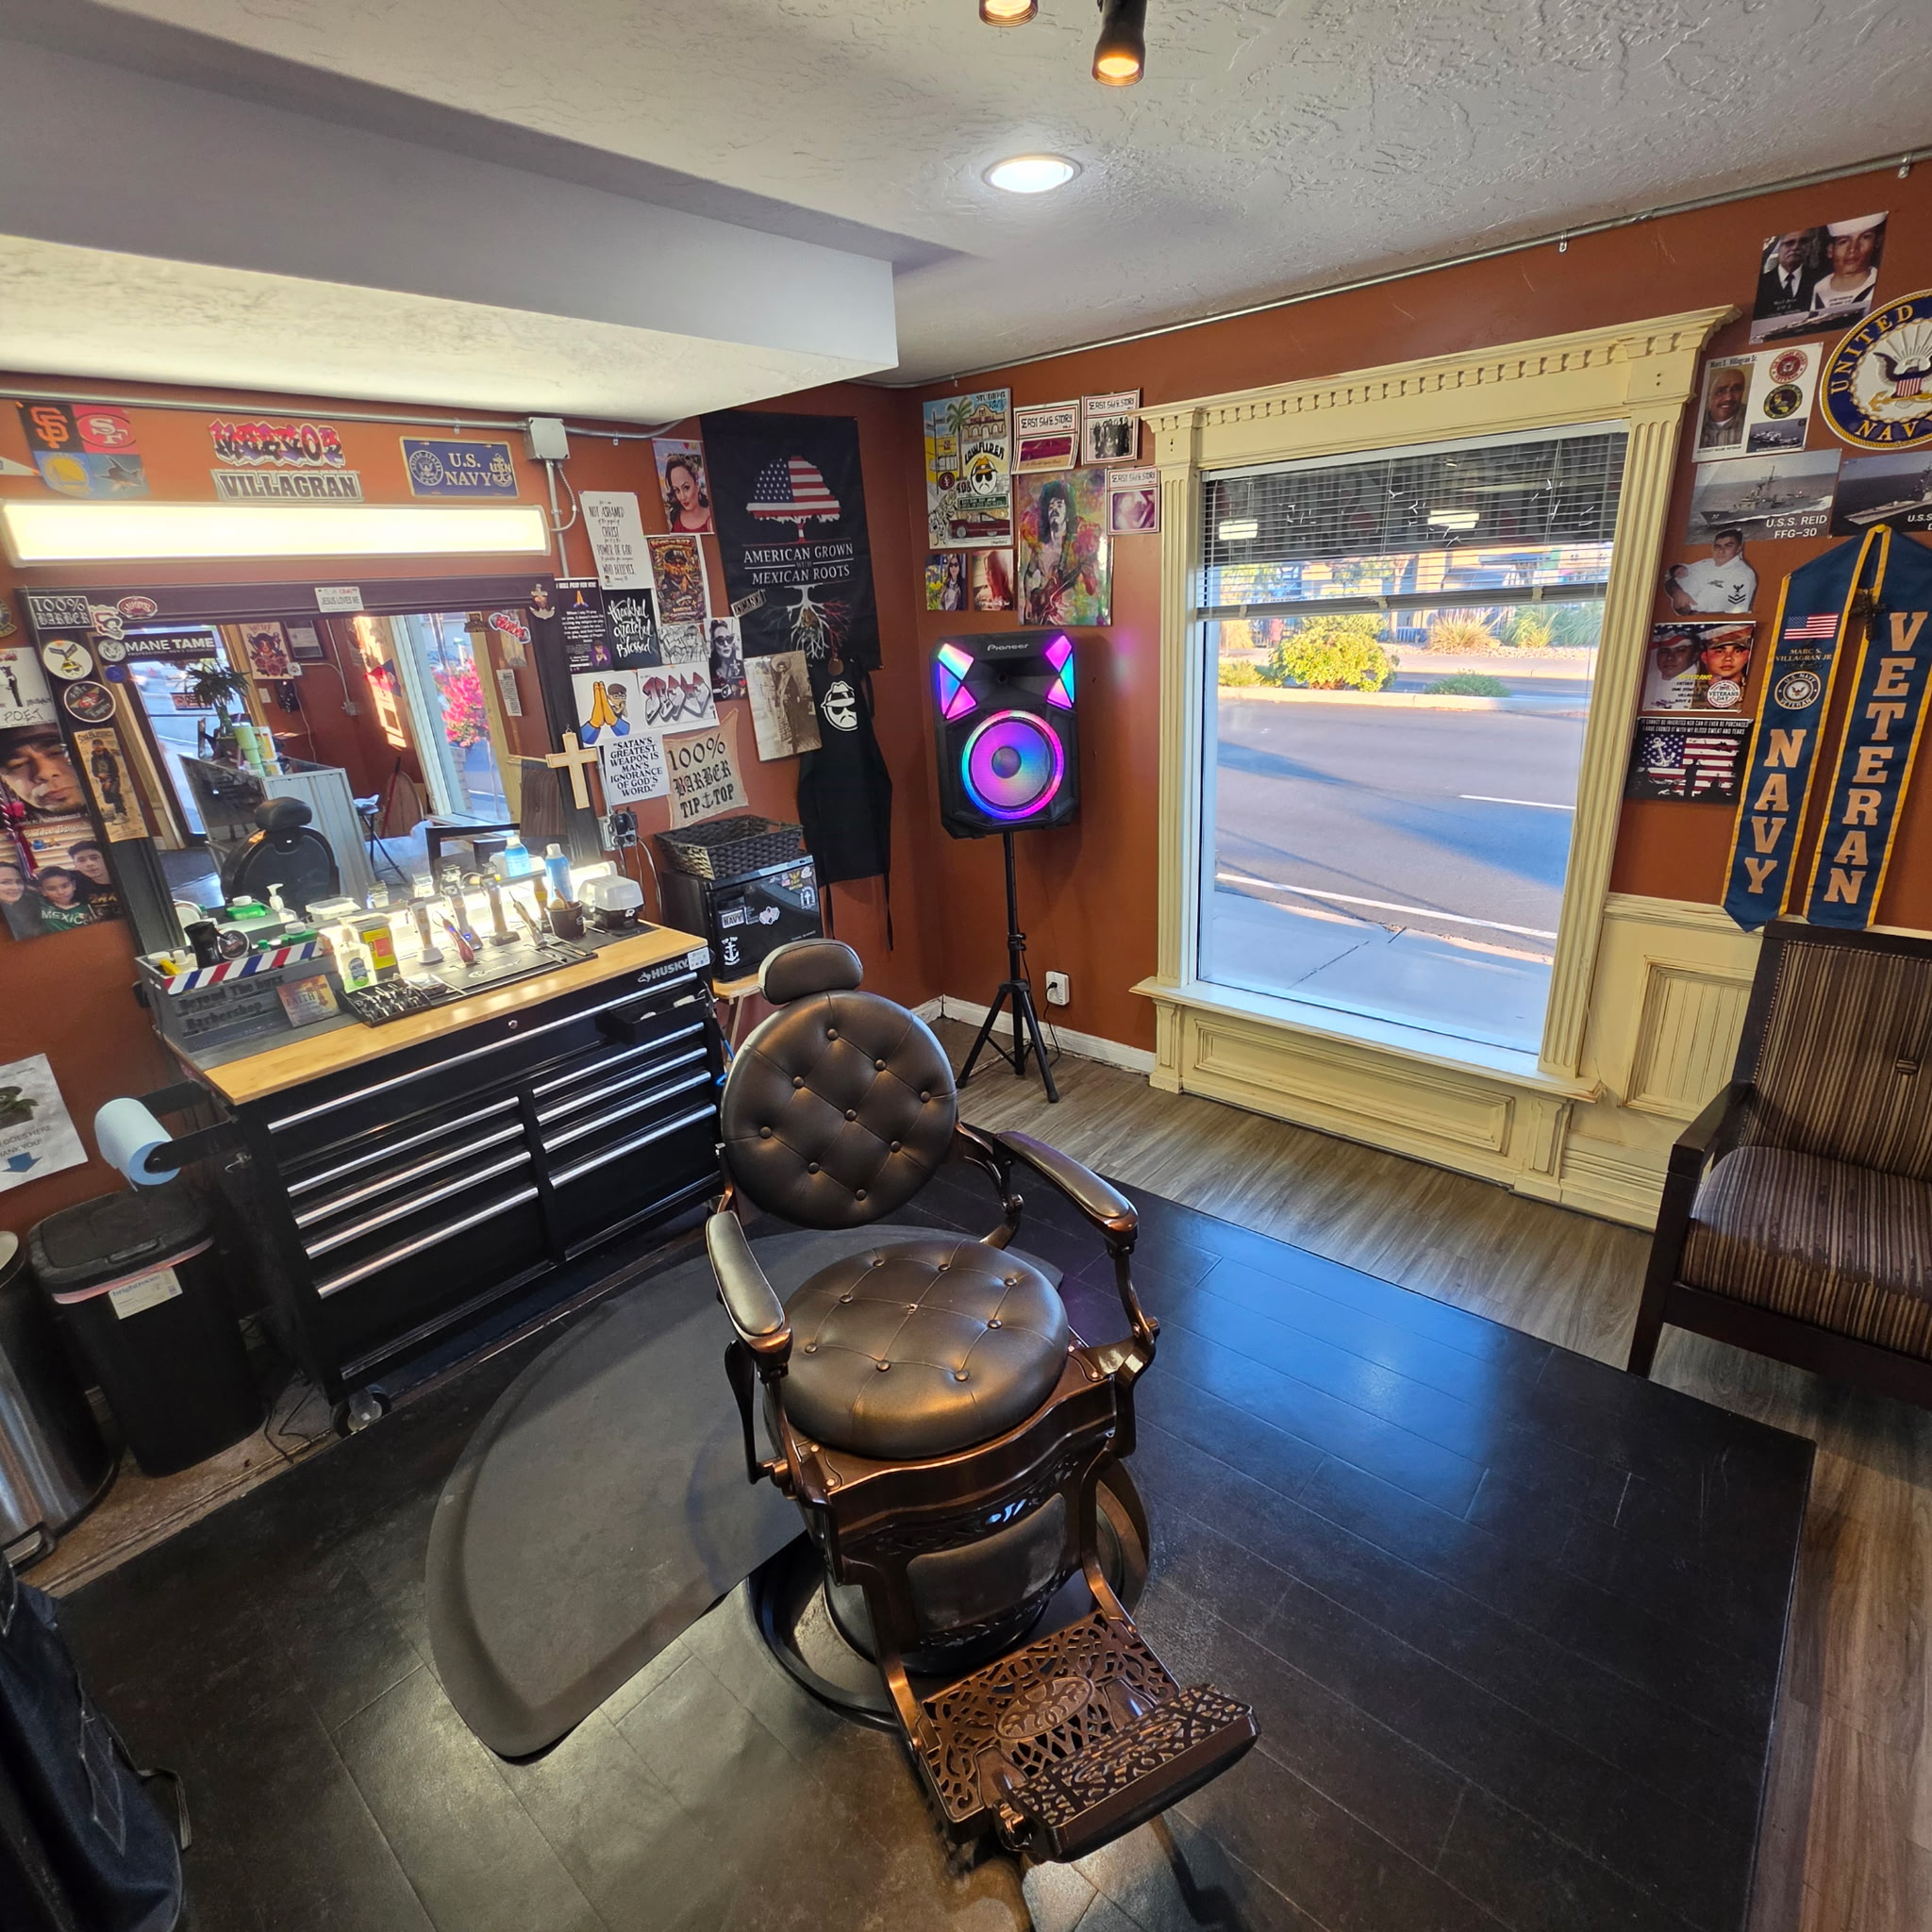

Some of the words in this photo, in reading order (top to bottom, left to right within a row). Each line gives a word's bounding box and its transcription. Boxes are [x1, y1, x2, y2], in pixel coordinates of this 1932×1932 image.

[1831, 305, 1913, 394] UNITED
[1089, 401, 1106, 410] EAST
[1107, 399, 1120, 408] SIDE
[1121, 397, 1135, 408] STORY
[1021, 418, 1039, 429] EAST
[1039, 415, 1054, 427] SIDE
[1054, 413, 1073, 425] STORY
[1856, 415, 1932, 441] NAV
[448, 453, 481, 468] U.S.
[490, 462, 511, 473] USN
[444, 472, 491, 486] NAVY
[1111, 474, 1129, 483] EAST
[1141, 472, 1156, 481] STORY
[219, 475, 358, 498] VILLAGRAN
[589, 507, 600, 518] NOT
[602, 507, 625, 518] ASHAMED
[1766, 518, 1797, 528] U.S.S.
[1800, 515, 1827, 525] REID
[602, 526, 620, 538] CHRIST
[1774, 528, 1817, 540] FFG-30
[596, 544, 614, 556] POWER
[614, 544, 621, 556] OF
[622, 544, 633, 556] GOD
[743, 547, 810, 564] AMERICAN
[814, 543, 854, 558] GROWN
[602, 564, 613, 575] WHO
[752, 569, 809, 585] MEXICAN
[813, 564, 850, 581] ROOTS
[33, 598, 85, 612] 100%
[337, 596, 352, 605] LOVES
[352, 595, 360, 604] ME
[608, 597, 649, 624] thankful
[36, 612, 91, 625] BARBER
[613, 619, 653, 643] grateful
[125, 641, 170, 653] MANE
[172, 638, 215, 649] TAME
[616, 636, 652, 658] Blessed
[1799, 674, 1816, 683] NAVY
[1780, 698, 1811, 708] VETERAN
[5, 708, 43, 723] POET
[610, 745, 657, 759] GREATEST
[610, 755, 649, 767] WEAPON
[650, 752, 659, 760] IS
[667, 733, 725, 771] 100%
[1824, 611, 1928, 905] VETERAN
[609, 767, 662, 783] IGNORANCE
[673, 759, 732, 797] BARBER
[617, 782, 630, 791] OF
[631, 775, 658, 788] GOD'S
[680, 798, 700, 819] TIP
[712, 783, 734, 807] TOP
[1745, 729, 1807, 894] NAVY
[724, 913, 743, 925] NAVY
[652, 958, 689, 979] HUSKY
[286, 992, 315, 1007] FAITH
[27, 1125, 53, 1138] HERE
[0, 1147, 21, 1158] HANK
